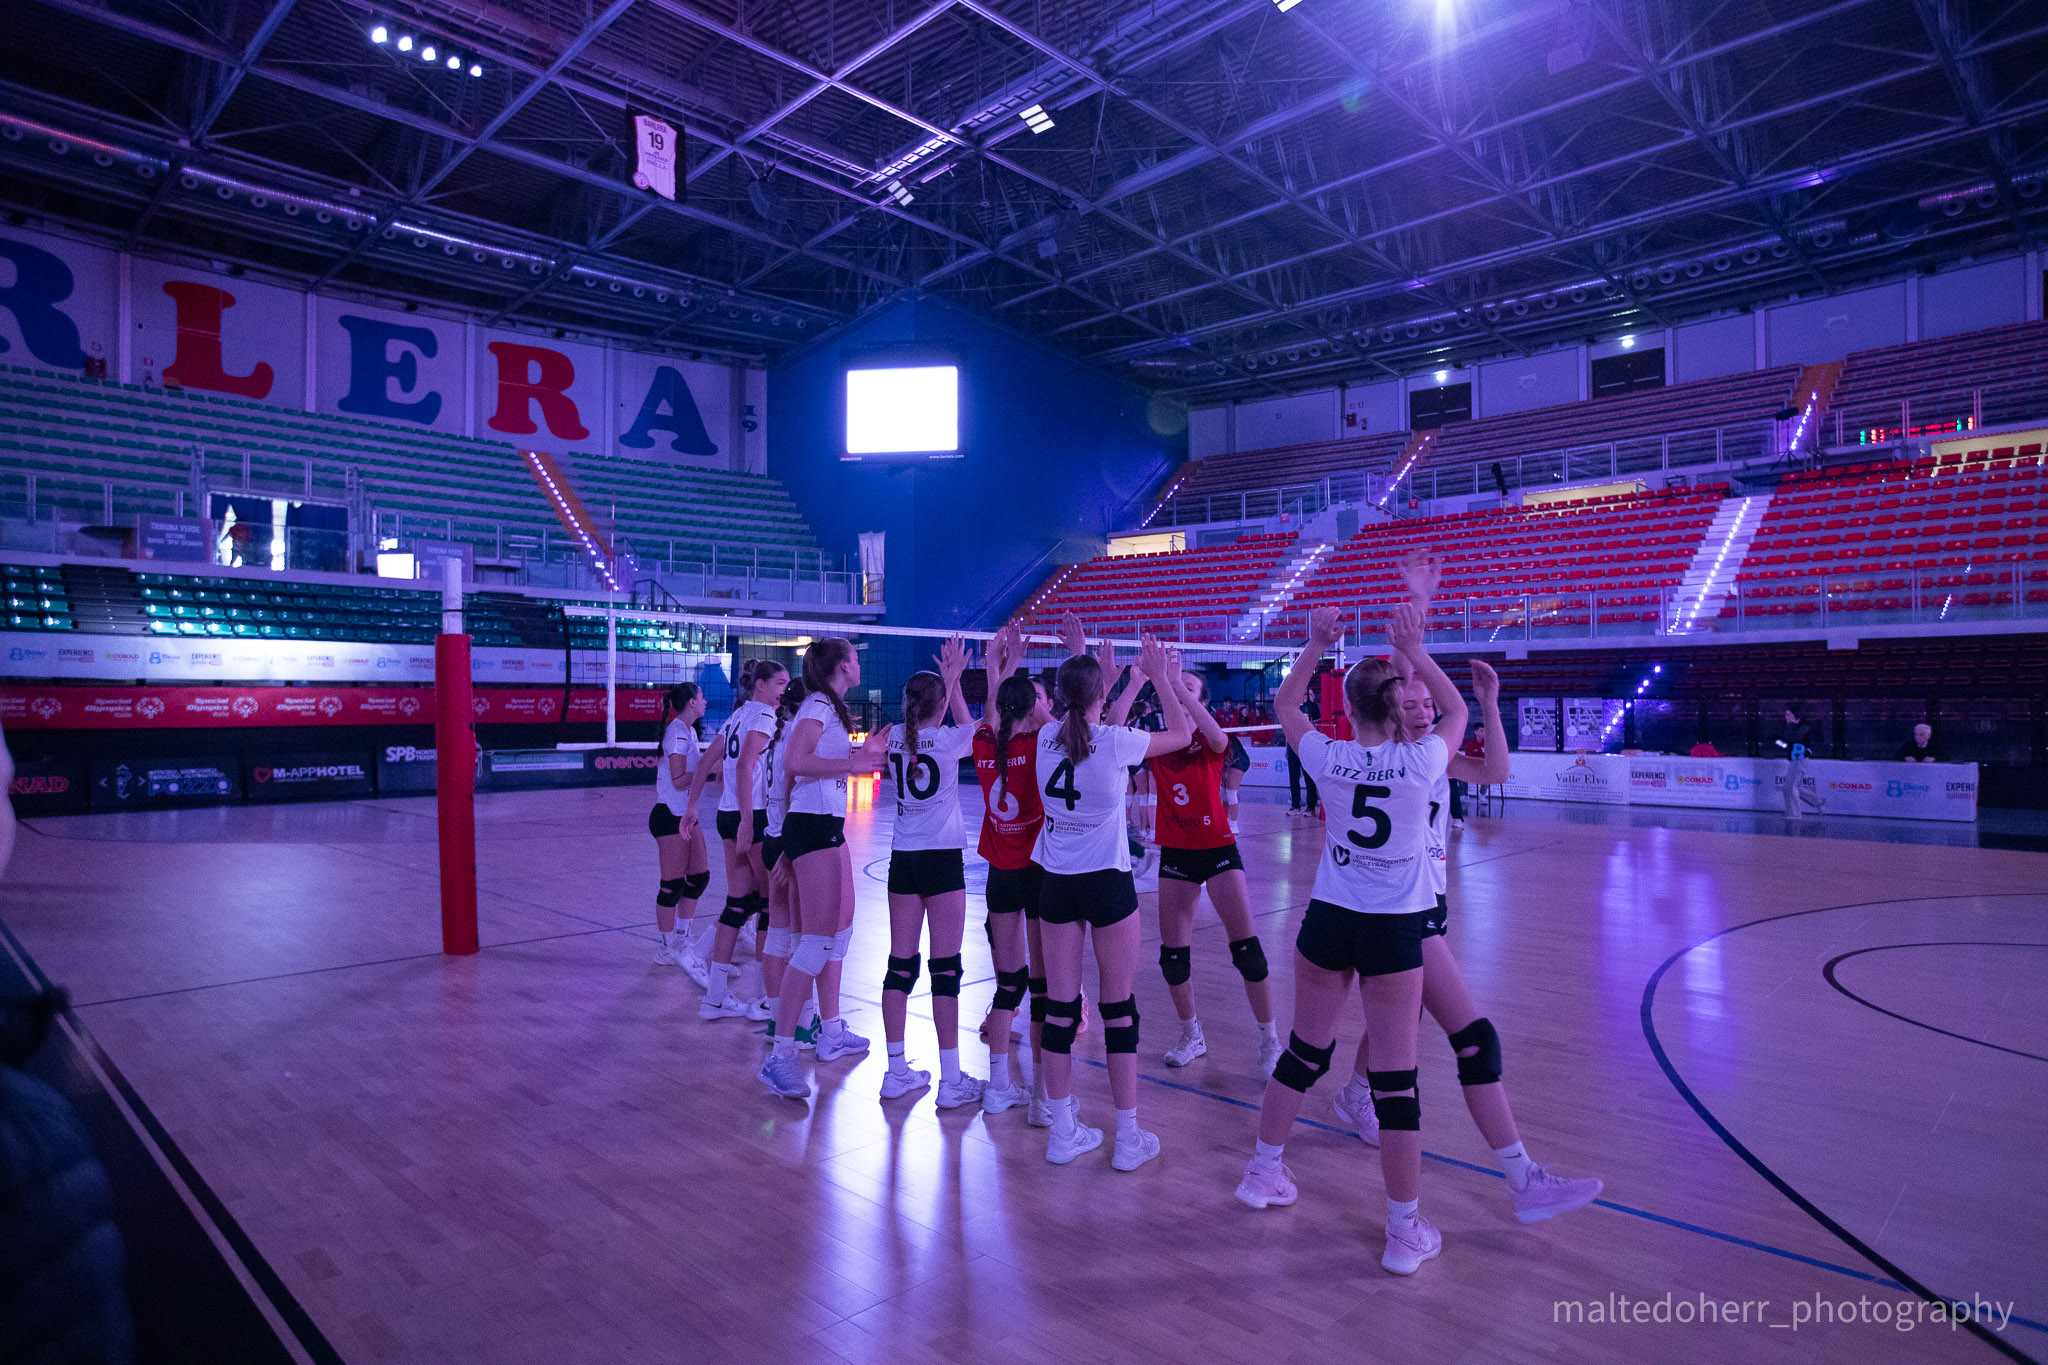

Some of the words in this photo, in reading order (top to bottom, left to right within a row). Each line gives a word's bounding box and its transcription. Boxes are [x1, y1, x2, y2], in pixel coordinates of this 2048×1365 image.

[648, 131, 664, 150] 19
[723, 721, 741, 760] 16
[889, 740, 905, 750] RTZ
[1041, 739, 1063, 752] RTZ
[386, 746, 416, 762] SPB
[595, 756, 658, 769] enerco
[1007, 755, 1026, 767] ERN
[889, 753, 940, 800] 10
[1331, 764, 1362, 780] RTZ
[1555, 772, 1581, 783] Valle
[1584, 774, 1608, 784] Elvo
[1631, 771, 1666, 780] EXPERIENCE
[1045, 758, 1081, 811] 4
[1838, 782, 1872, 790] CONAD
[989, 775, 1019, 822] 6
[1172, 783, 1190, 806] 3
[1346, 784, 1392, 849] 5
[1055, 825, 1085, 833] VOLLEYBALL
[1352, 858, 1391, 869] VOLLEYBALL
[1355, 855, 1414, 864] EISTUNGSZENTRUM
